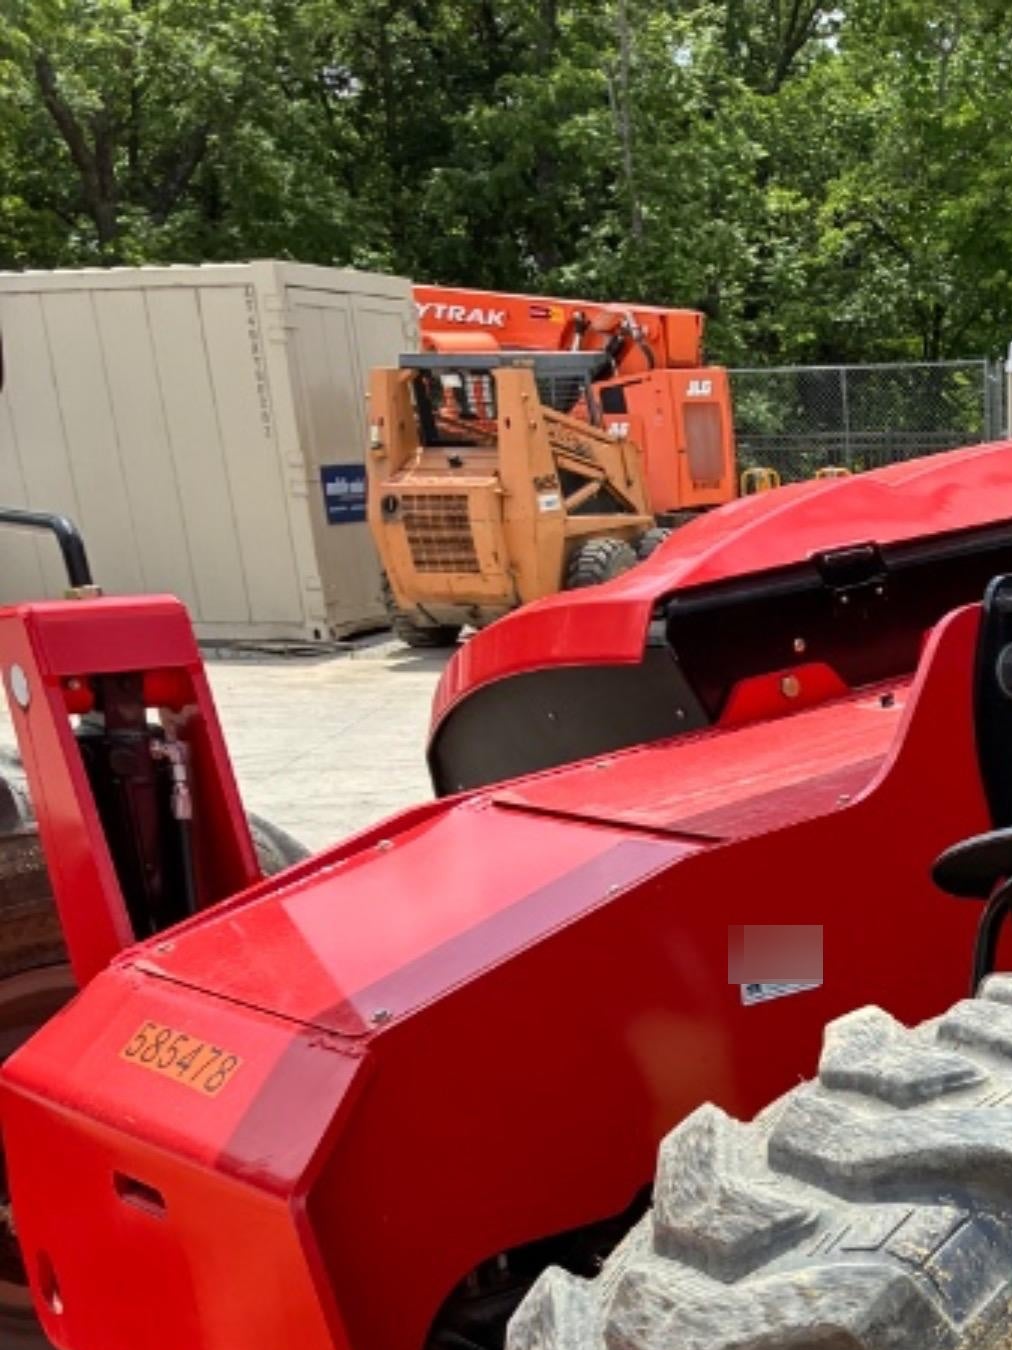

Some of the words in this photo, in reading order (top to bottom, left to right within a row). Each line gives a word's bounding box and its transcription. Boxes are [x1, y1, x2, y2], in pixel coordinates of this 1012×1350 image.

[415, 302, 506, 327] YTRAK
[686, 379, 713, 398] JLG
[125, 1022, 238, 1092] 585478
